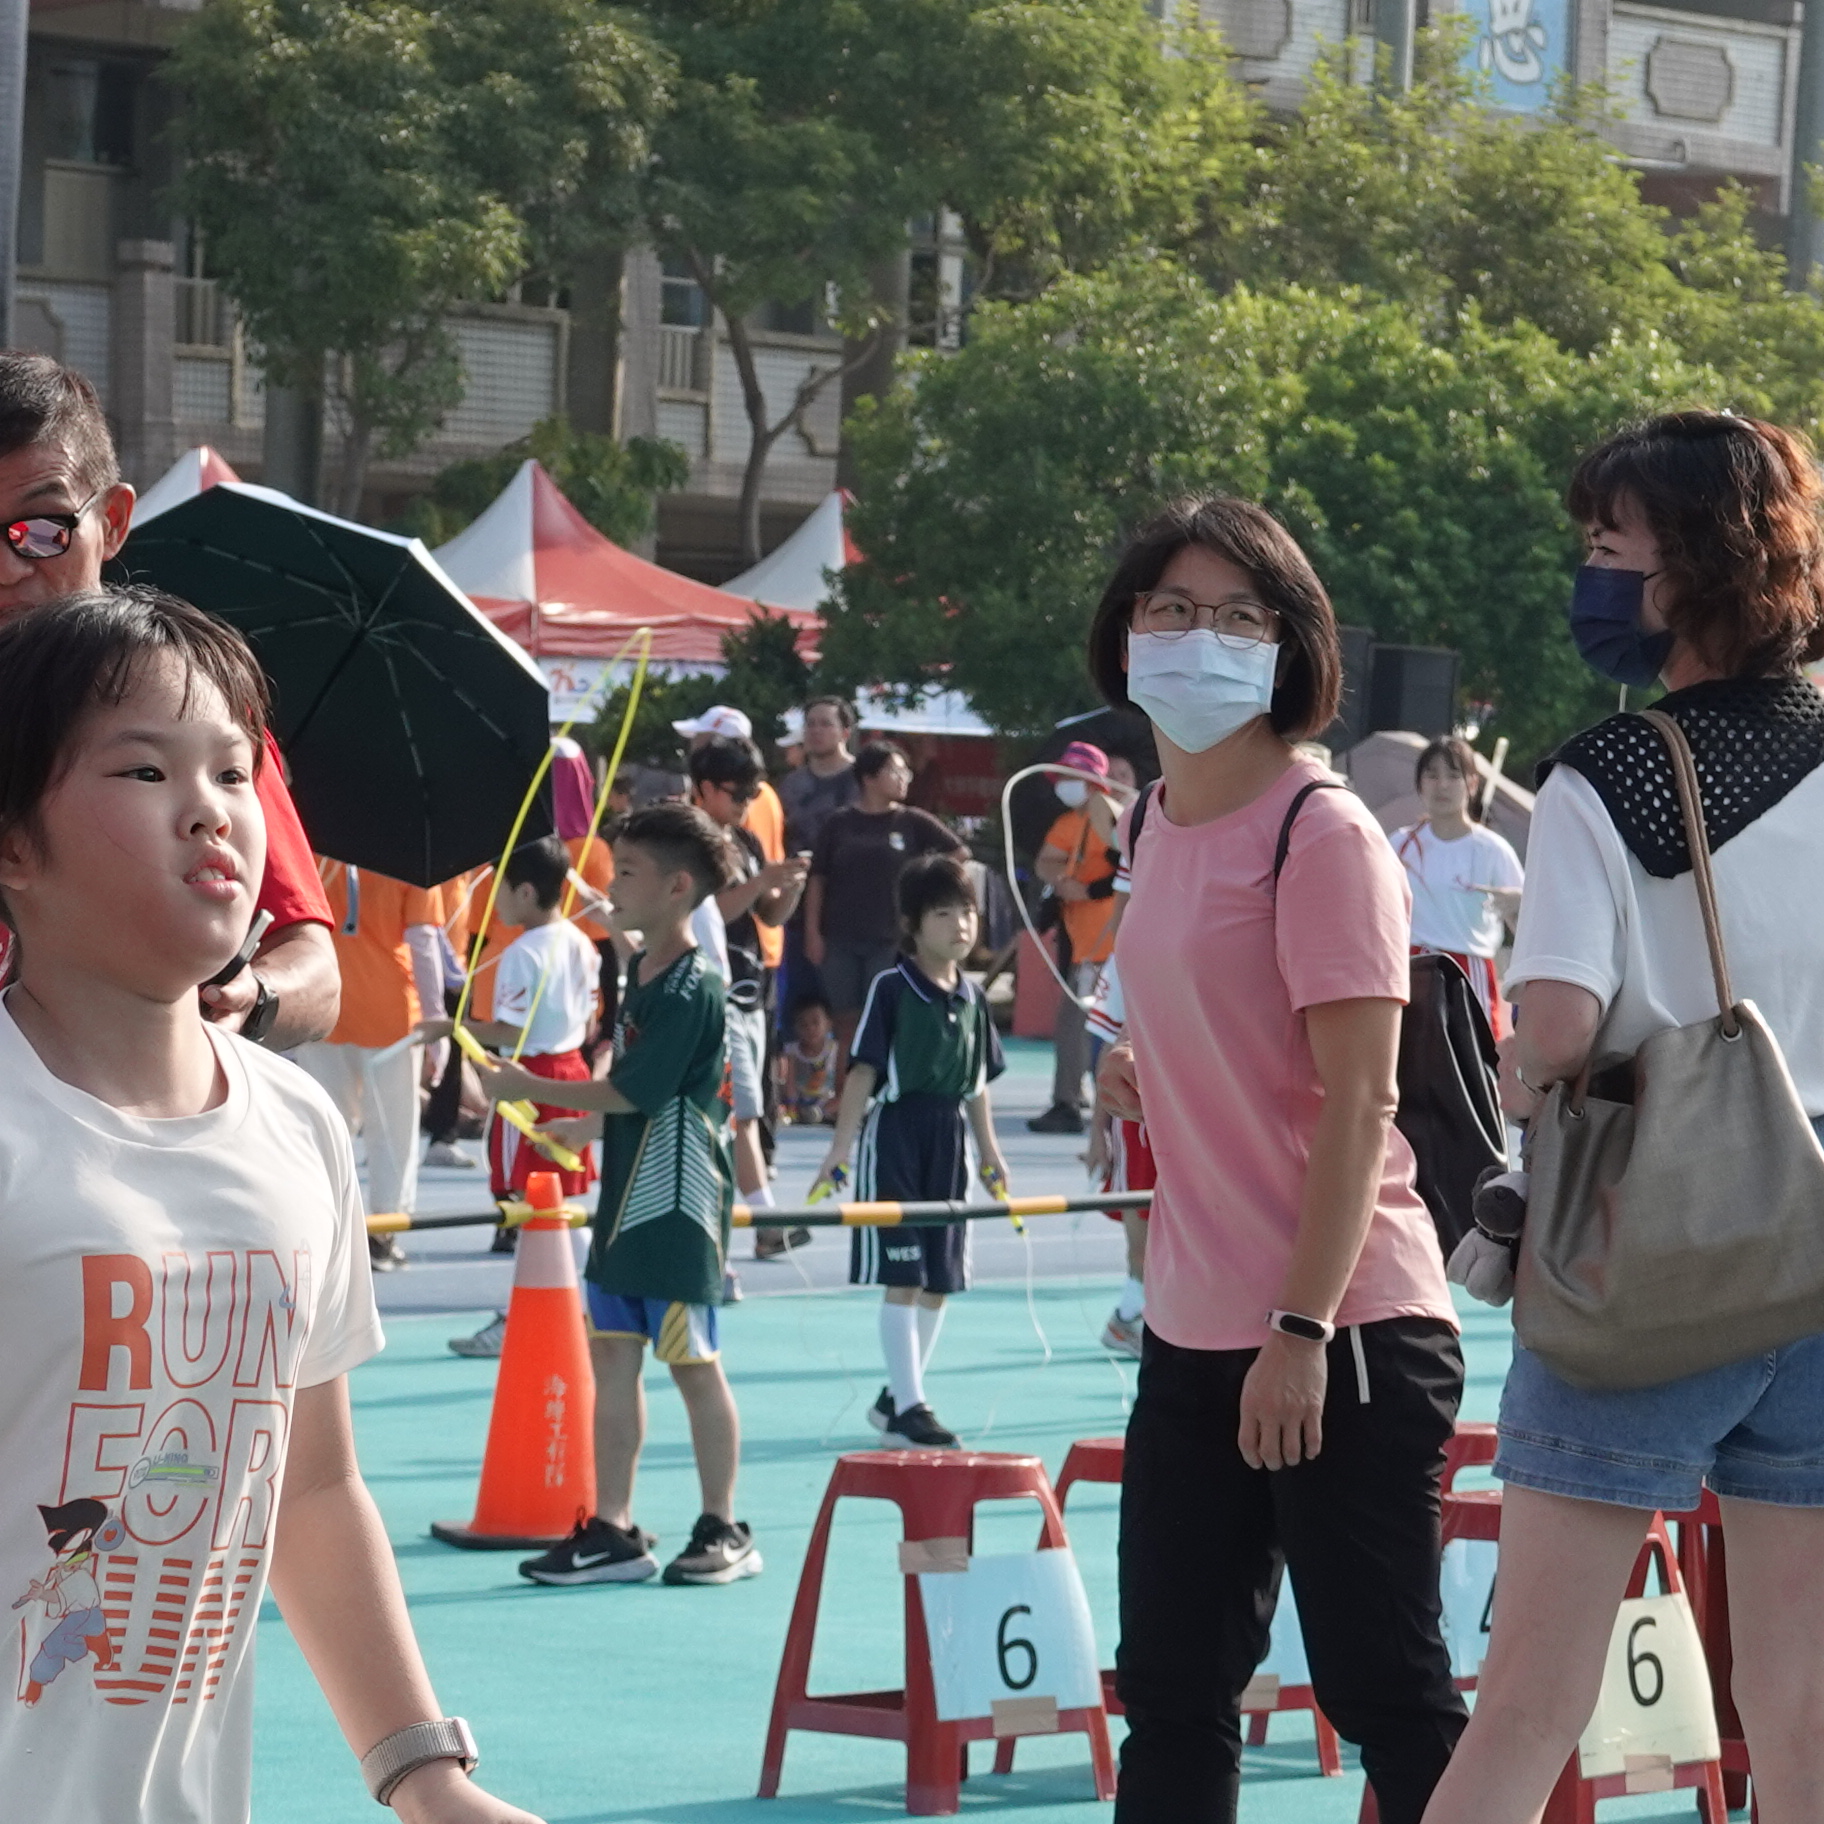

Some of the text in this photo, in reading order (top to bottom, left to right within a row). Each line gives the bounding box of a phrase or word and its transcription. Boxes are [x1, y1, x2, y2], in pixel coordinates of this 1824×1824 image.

[78, 1249, 312, 1391] RUN
[59, 1397, 289, 1552] FOR
[18, 1555, 260, 1706] UN
[996, 1604, 1038, 1690] 6
[1627, 1615, 1665, 1707] 6
